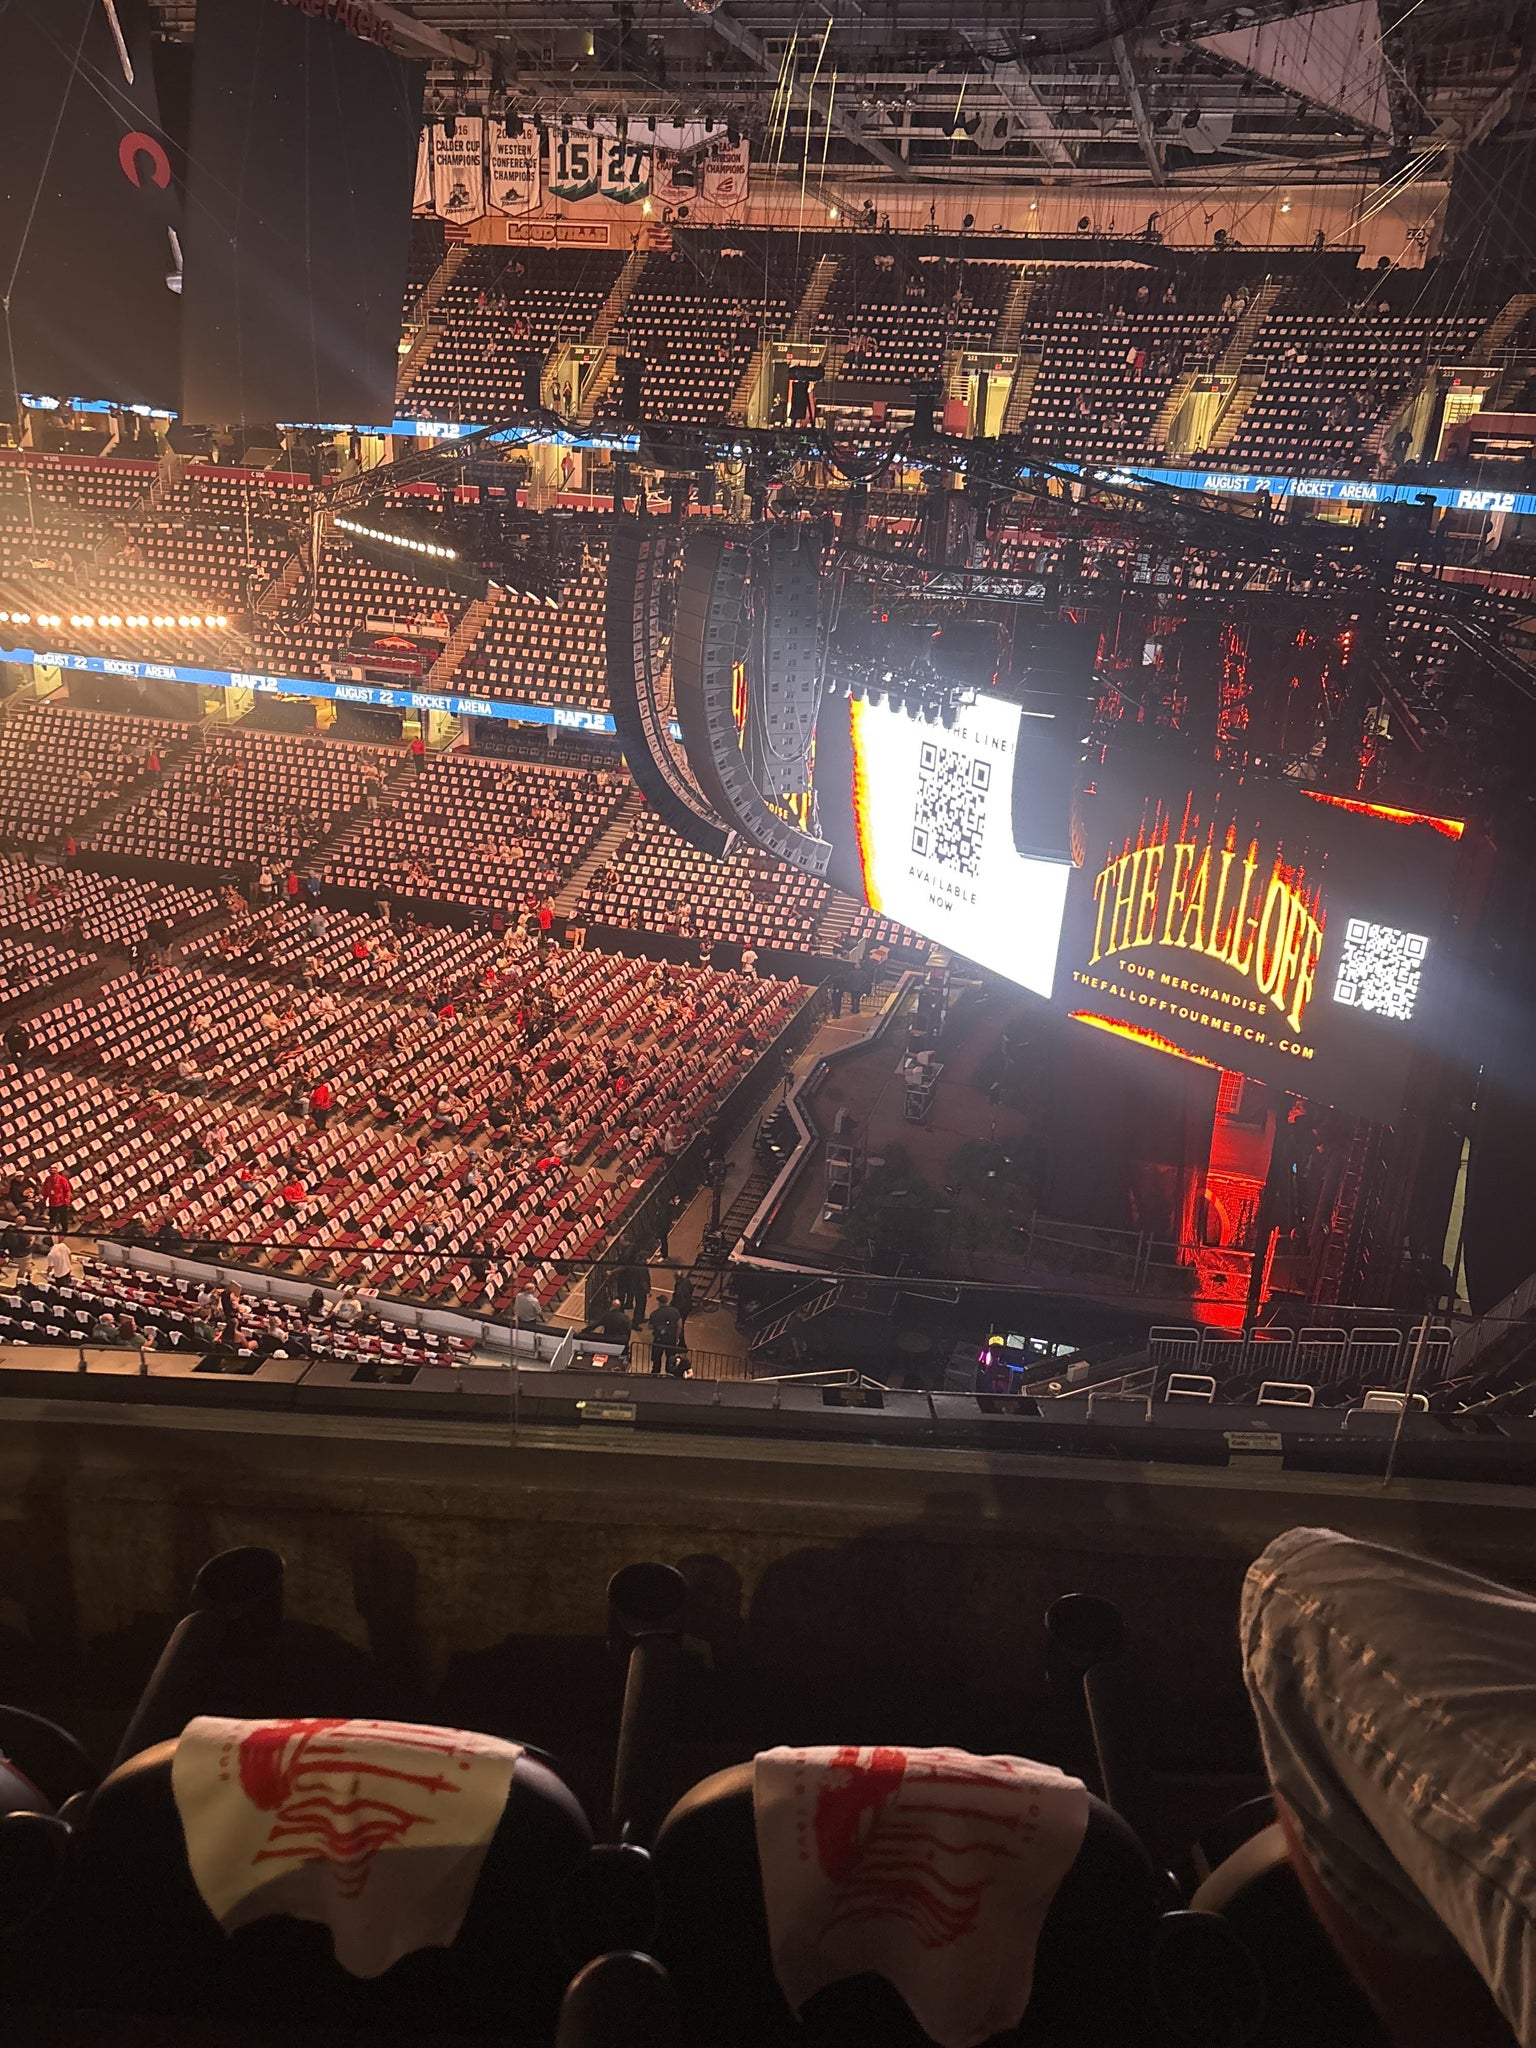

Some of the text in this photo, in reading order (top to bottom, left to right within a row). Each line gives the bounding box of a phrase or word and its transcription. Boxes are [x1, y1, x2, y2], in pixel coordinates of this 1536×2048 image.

[436, 140, 480, 152] CALDER CUP
[497, 144, 532, 155] WESTERN
[436, 154, 480, 166] CHAMPIONS
[557, 143, 589, 180] 15
[608, 145, 650, 183] 27
[706, 164, 745, 175] CHAMPIONS
[1203, 475, 1251, 490] AUGUST
[1338, 486, 1378, 499] ARENA
[33, 652, 69, 667] AUGUST
[73, 657, 88, 669] 22
[103, 659, 141, 676] ROCKET
[143, 665, 177, 679] ARENA
[335, 685, 374, 701] AUGUST
[379, 691, 394, 703] 22
[411, 695, 452, 710] ROCKET
[457, 700, 493, 714] ARENA
[908, 866, 978, 905] AVAILABLE
[929, 893, 954, 912] NOW
[1087, 843, 1165, 967] THE
[1118, 959, 1268, 1017] TOUR MERCHANDISE
